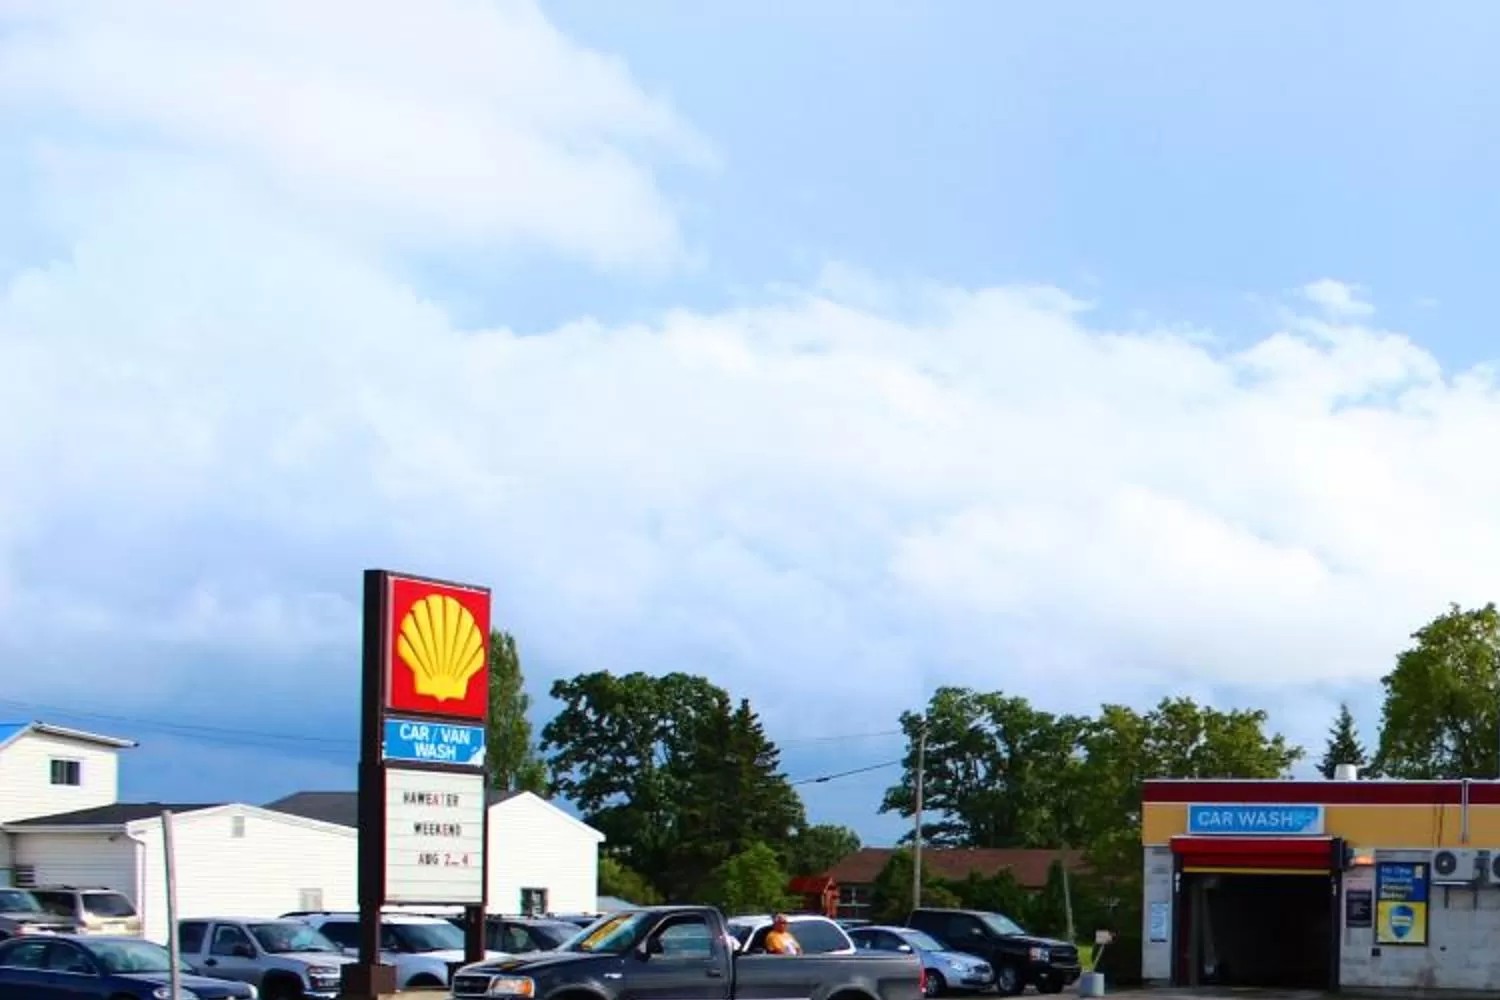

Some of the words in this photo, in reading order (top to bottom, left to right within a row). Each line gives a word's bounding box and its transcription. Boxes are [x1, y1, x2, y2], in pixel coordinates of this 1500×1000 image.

[400, 723, 430, 740] CAR
[441, 728, 471, 744] VAN
[415, 742, 457, 760] WASH
[1198, 811, 1233, 826] CAR
[1237, 811, 1293, 827] WASH
[413, 823, 462, 837] WEEKEND
[418, 852, 438, 865] AUG
